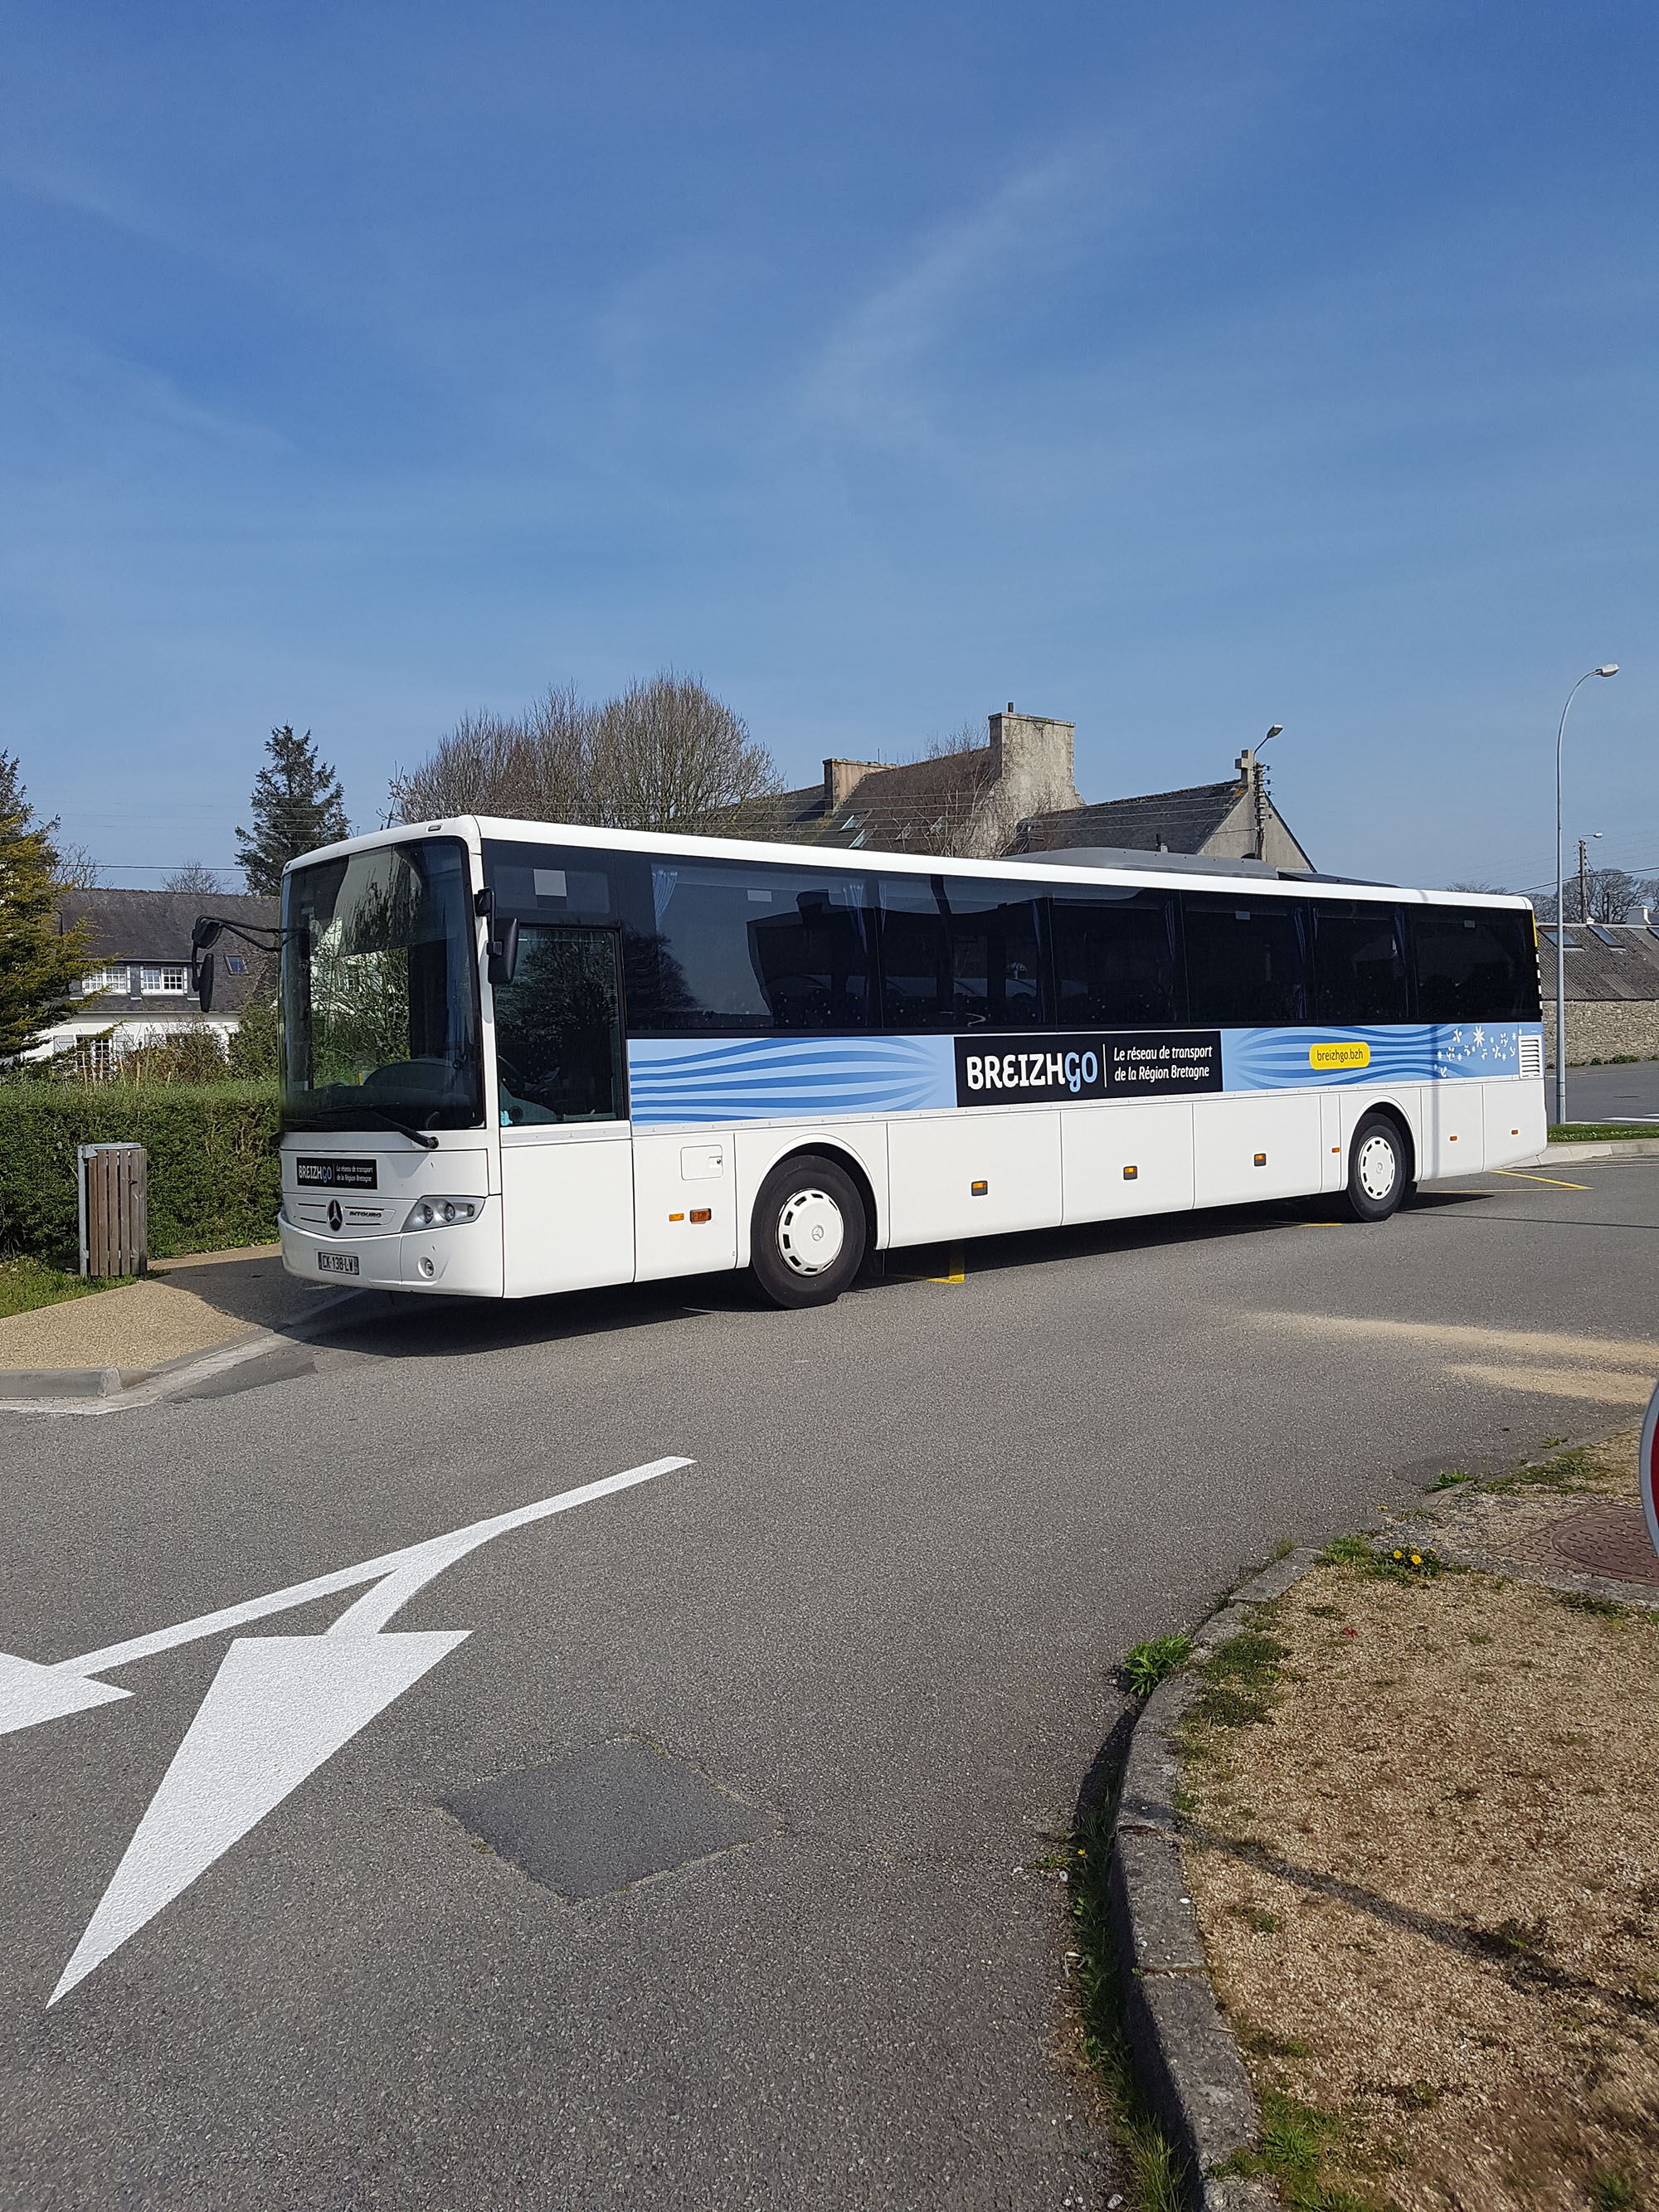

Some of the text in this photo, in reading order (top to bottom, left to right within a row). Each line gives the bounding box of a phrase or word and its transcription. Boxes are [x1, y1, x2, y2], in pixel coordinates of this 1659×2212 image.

[1113, 1045, 1213, 1061] Le réseau de transport
[1316, 1048, 1364, 1063] breizhgo.bzh
[966, 1052, 1098, 1092] BREIZHGO
[1114, 1064, 1210, 1083] de la Région Bretagne
[298, 1164, 332, 1184] BREIZHGO
